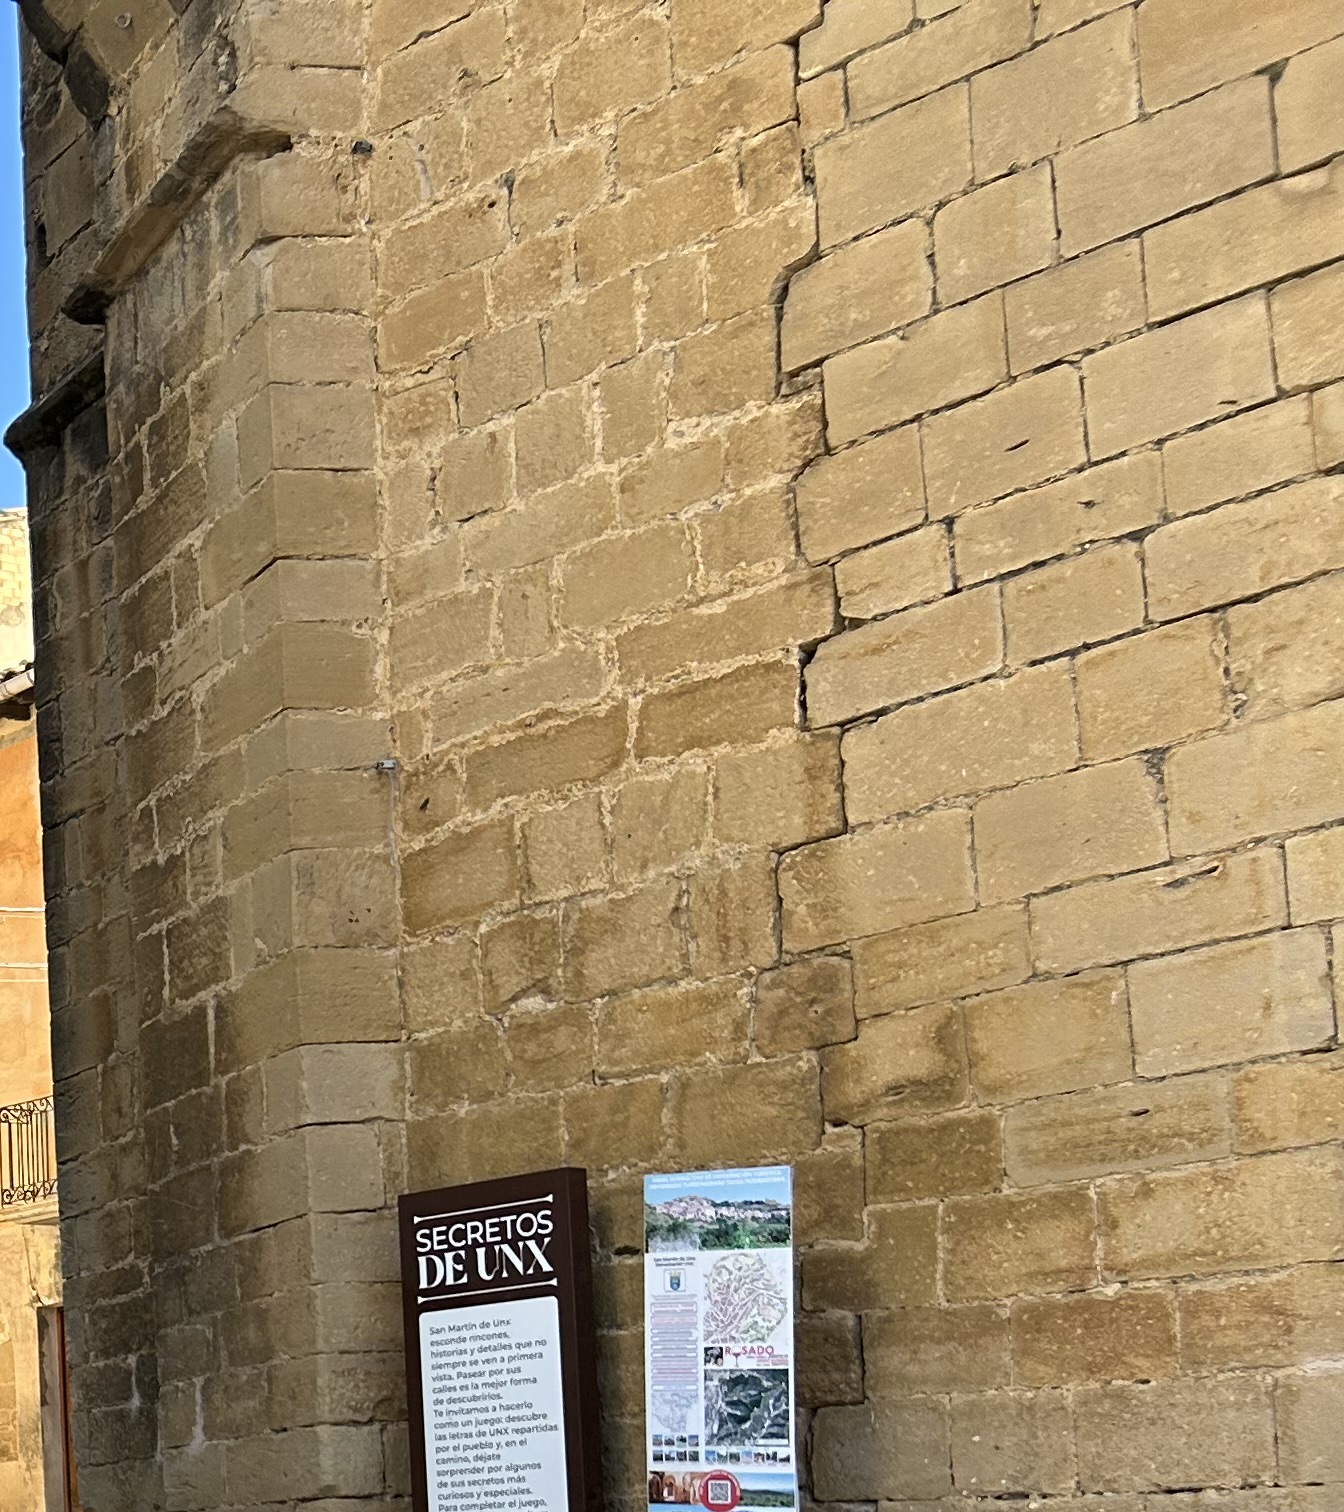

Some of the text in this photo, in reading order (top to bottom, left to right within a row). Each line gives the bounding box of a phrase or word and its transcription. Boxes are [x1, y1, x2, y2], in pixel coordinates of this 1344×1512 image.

[416, 1209, 555, 1253] SECRETOS
[417, 1236, 555, 1290] DE UNX
[429, 1319, 512, 1335] San Martín de Unx
[430, 1336, 467, 1347] esconde
[430, 1339, 547, 1359] historias y detalles que no
[431, 1351, 543, 1371] siempre se ven a primera
[457, 1370, 486, 1379] Pasear
[488, 1368, 504, 1377] por
[506, 1366, 522, 1375] sus
[432, 1376, 537, 1394] calles es la mejor forma
[433, 1397, 444, 1406] de
[433, 1409, 444, 1418] Te
[446, 1405, 489, 1417] invitamos
[499, 1401, 533, 1412] hacerlo
[434, 1420, 459, 1429] como
[461, 1419, 473, 1427] un
[505, 1412, 548, 1423] descubre
[434, 1423, 559, 1441] las letras de UNX repartidas
[435, 1445, 450, 1454] por
[452, 1443, 460, 1451] el
[462, 1440, 494, 1452] pueblo
[505, 1439, 517, 1447] en
[519, 1437, 527, 1446] el
[473, 1452, 501, 1463] déjate
[436, 1462, 542, 1477] sorprender por algunos
[437, 1480, 448, 1488] de
[450, 1479, 465, 1487] sus
[467, 1477, 505, 1487] secretos
[437, 1490, 474, 1500] curiosos
[476, 1491, 482, 1499] y
[438, 1503, 458, 1512] Para
[460, 1500, 506, 1510] completar
[508, 1499, 517, 1508] el
